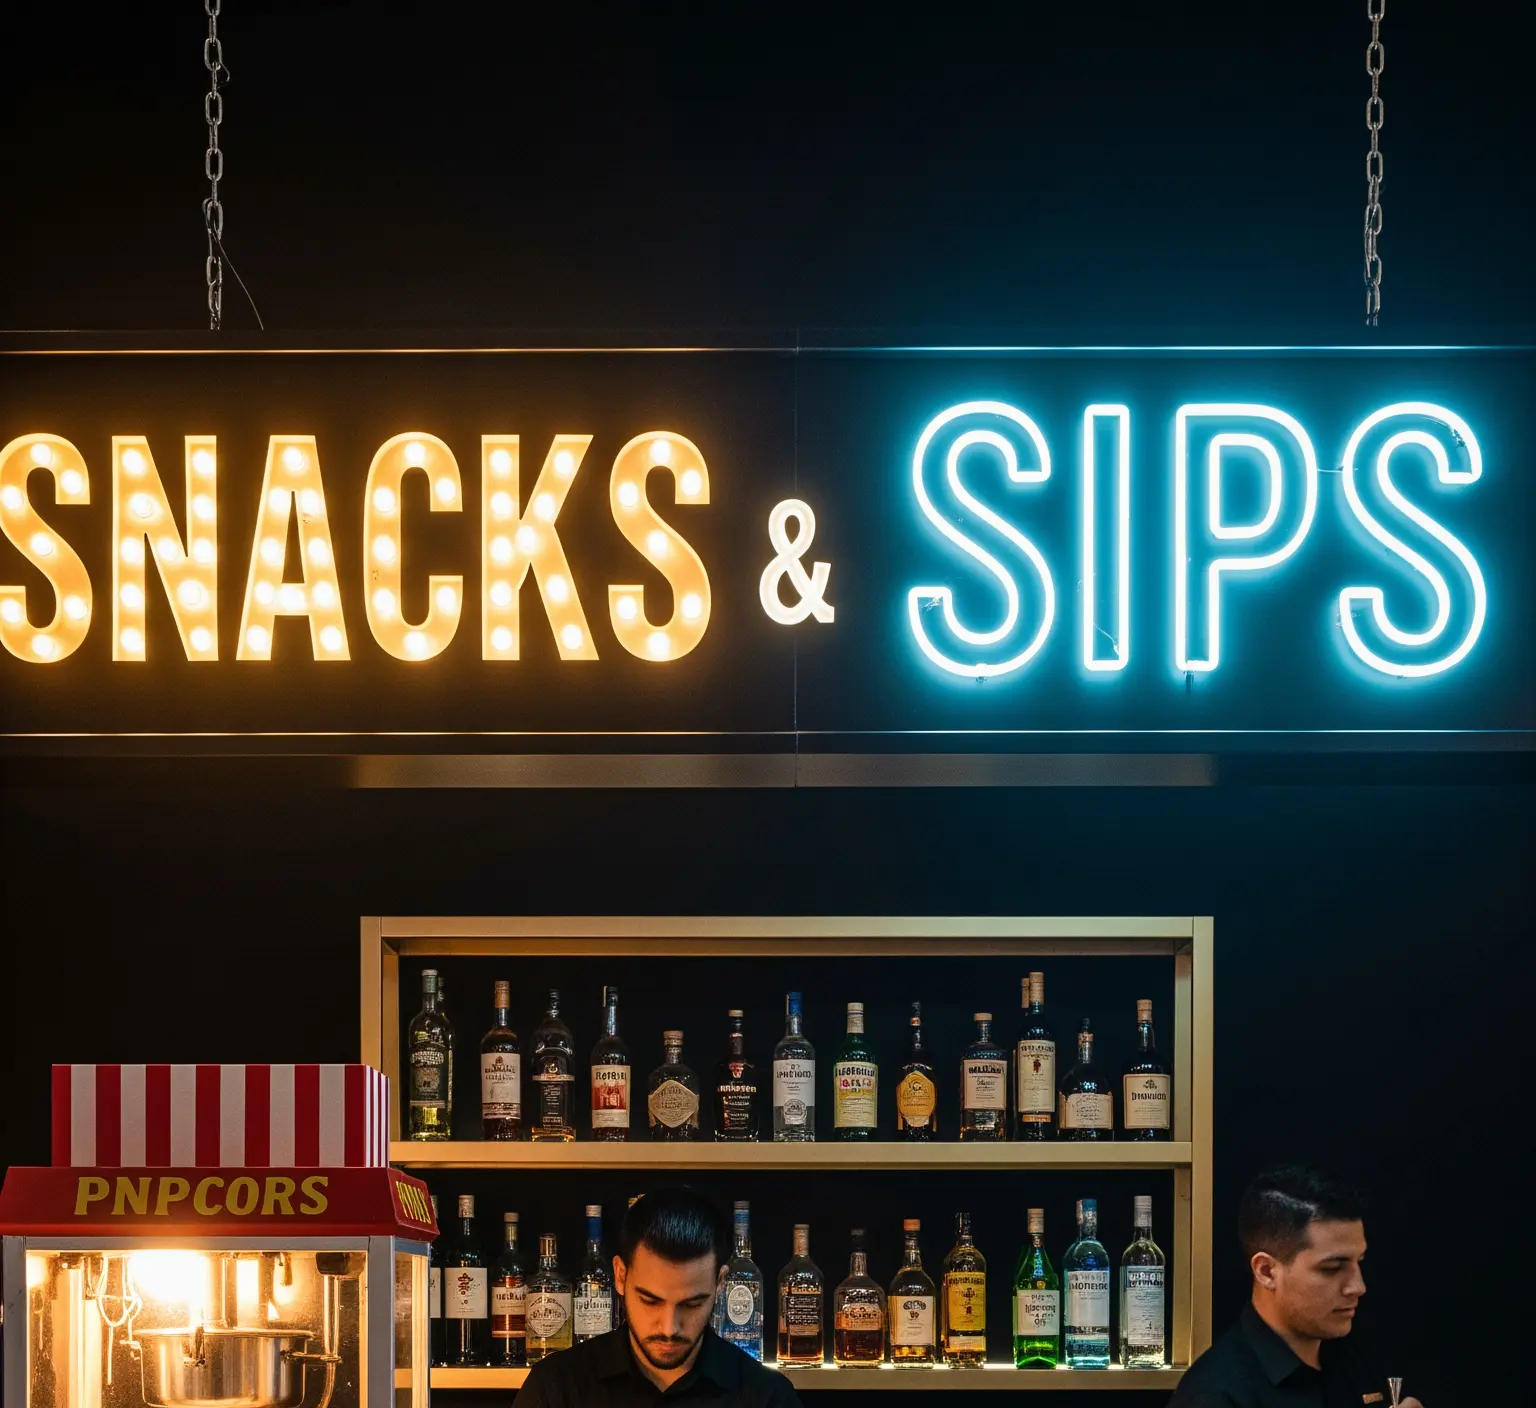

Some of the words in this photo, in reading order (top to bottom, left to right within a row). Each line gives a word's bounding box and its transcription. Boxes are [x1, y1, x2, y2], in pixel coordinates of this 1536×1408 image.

[0, 431, 711, 663] SNACKS
[757, 499, 835, 625] &
[908, 400, 1487, 678] SIPS
[74, 1176, 329, 1215] PNPCORS
